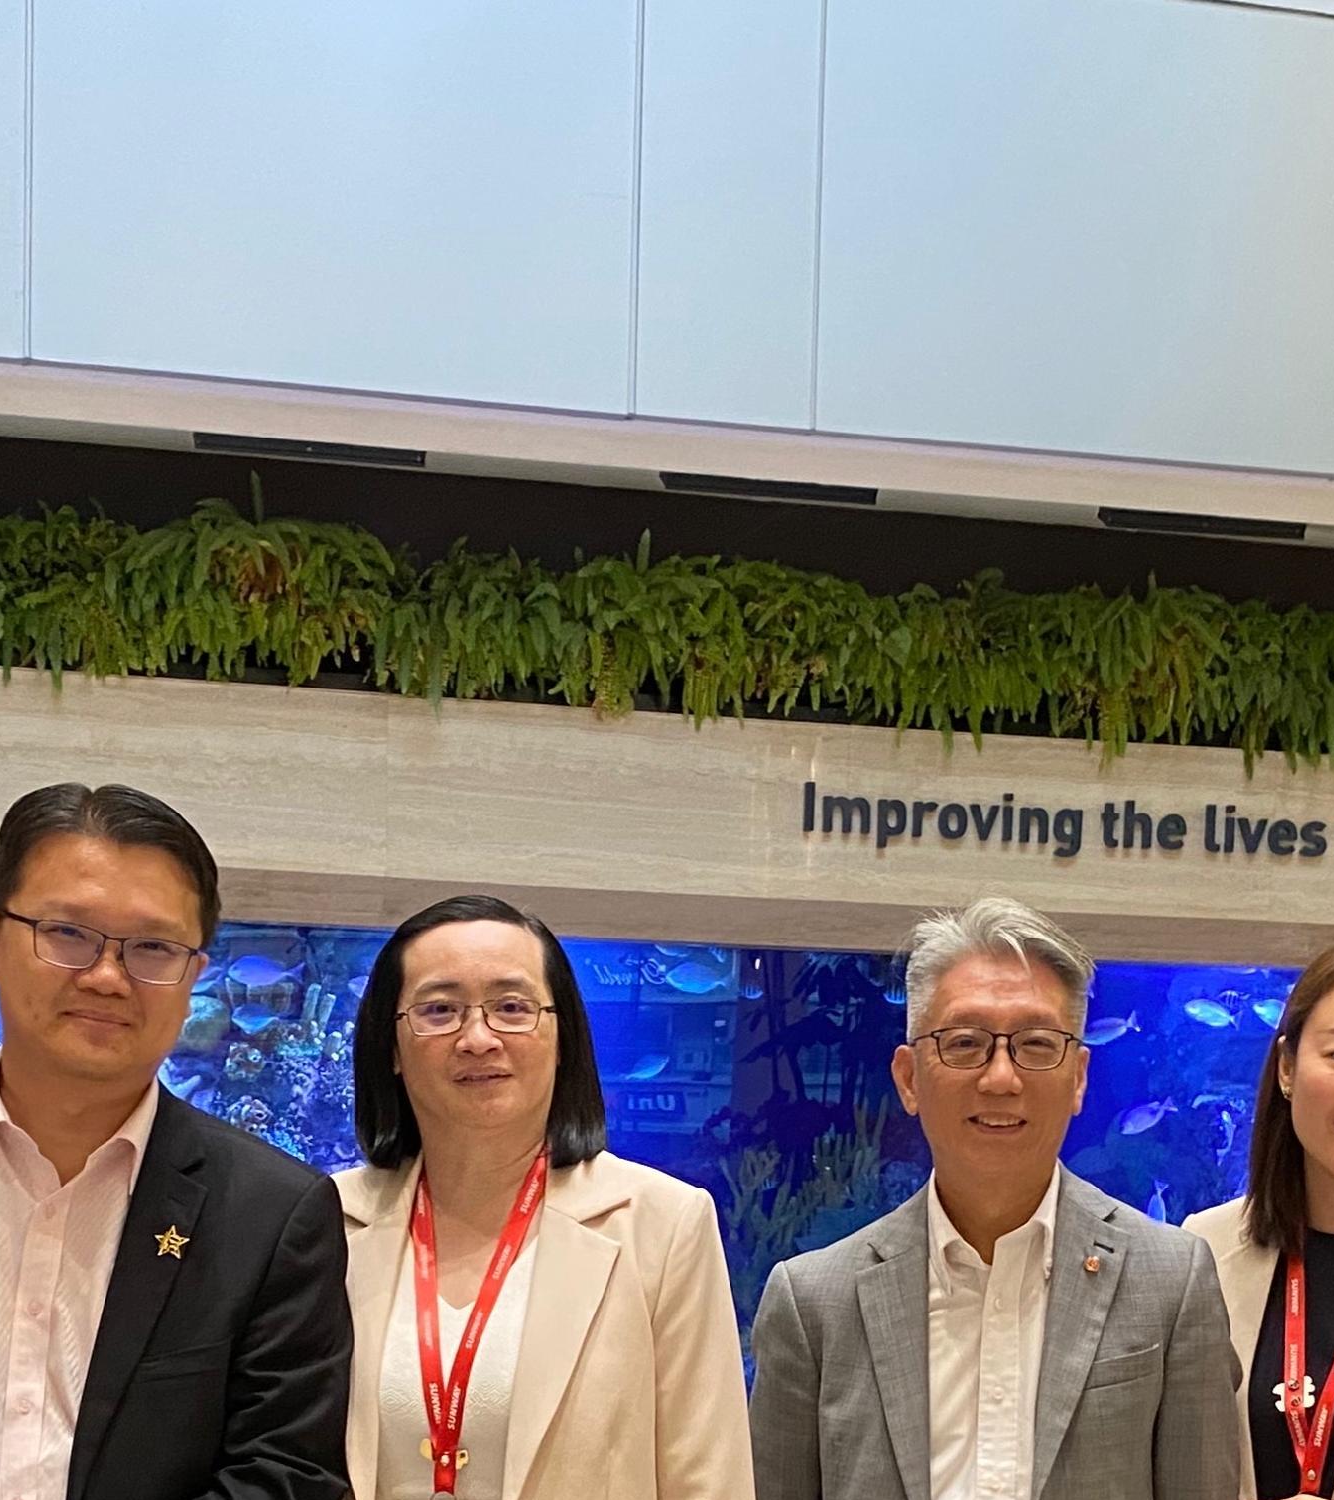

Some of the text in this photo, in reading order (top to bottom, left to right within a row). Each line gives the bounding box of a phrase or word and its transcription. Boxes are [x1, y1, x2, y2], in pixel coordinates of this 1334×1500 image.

[802, 781, 1084, 858] Improving
[1101, 800, 1187, 850] the
[1204, 804, 1328, 857] lives
[519, 1177, 540, 1215] SUNWAY
[447, 1382, 462, 1430] SUNWAY
[1312, 1404, 1329, 1447] SUNWAY
